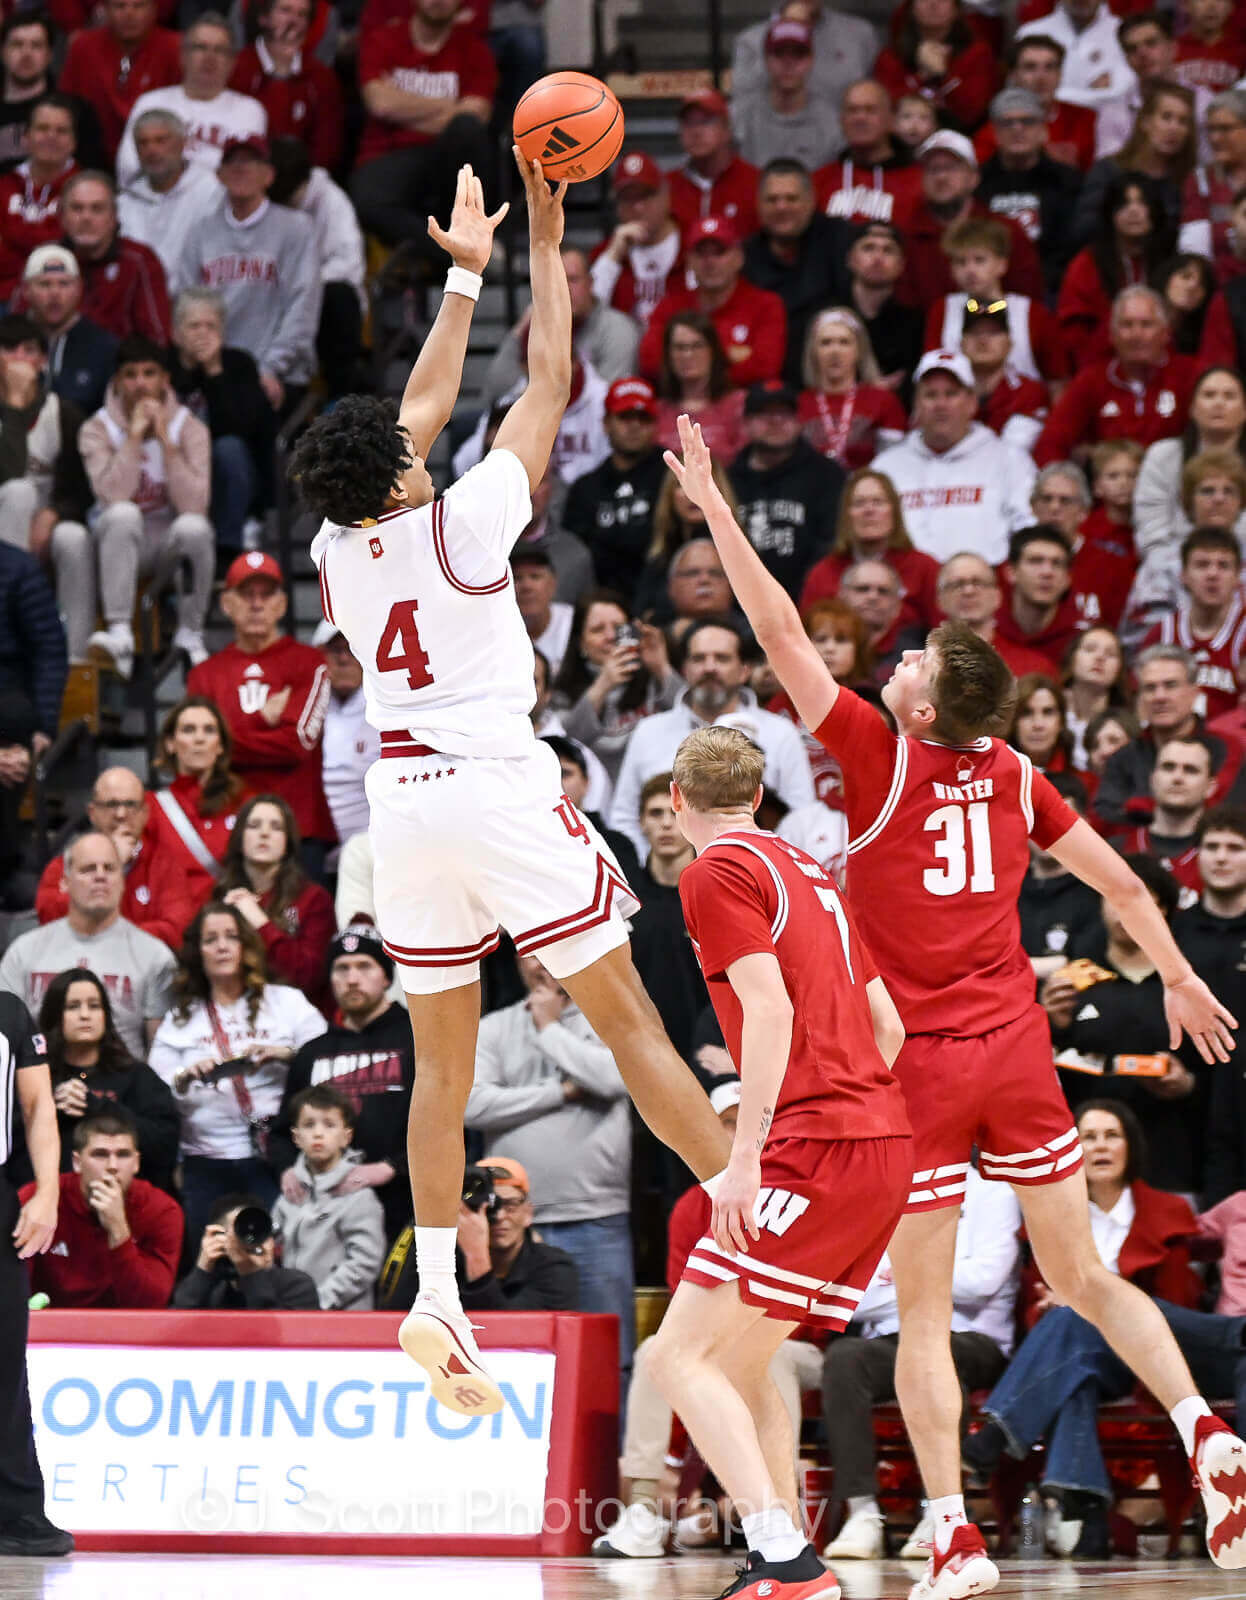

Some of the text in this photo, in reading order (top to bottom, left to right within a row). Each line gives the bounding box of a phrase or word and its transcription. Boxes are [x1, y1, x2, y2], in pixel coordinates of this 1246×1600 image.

[375, 599, 435, 691] 4
[931, 778, 994, 802] WINTER
[922, 801, 996, 897] 31
[813, 885, 856, 986] 7
[742, 1186, 812, 1238] W
[32, 1377, 548, 1441] OOMINGTON
[51, 1462, 311, 1506] ERTIES
